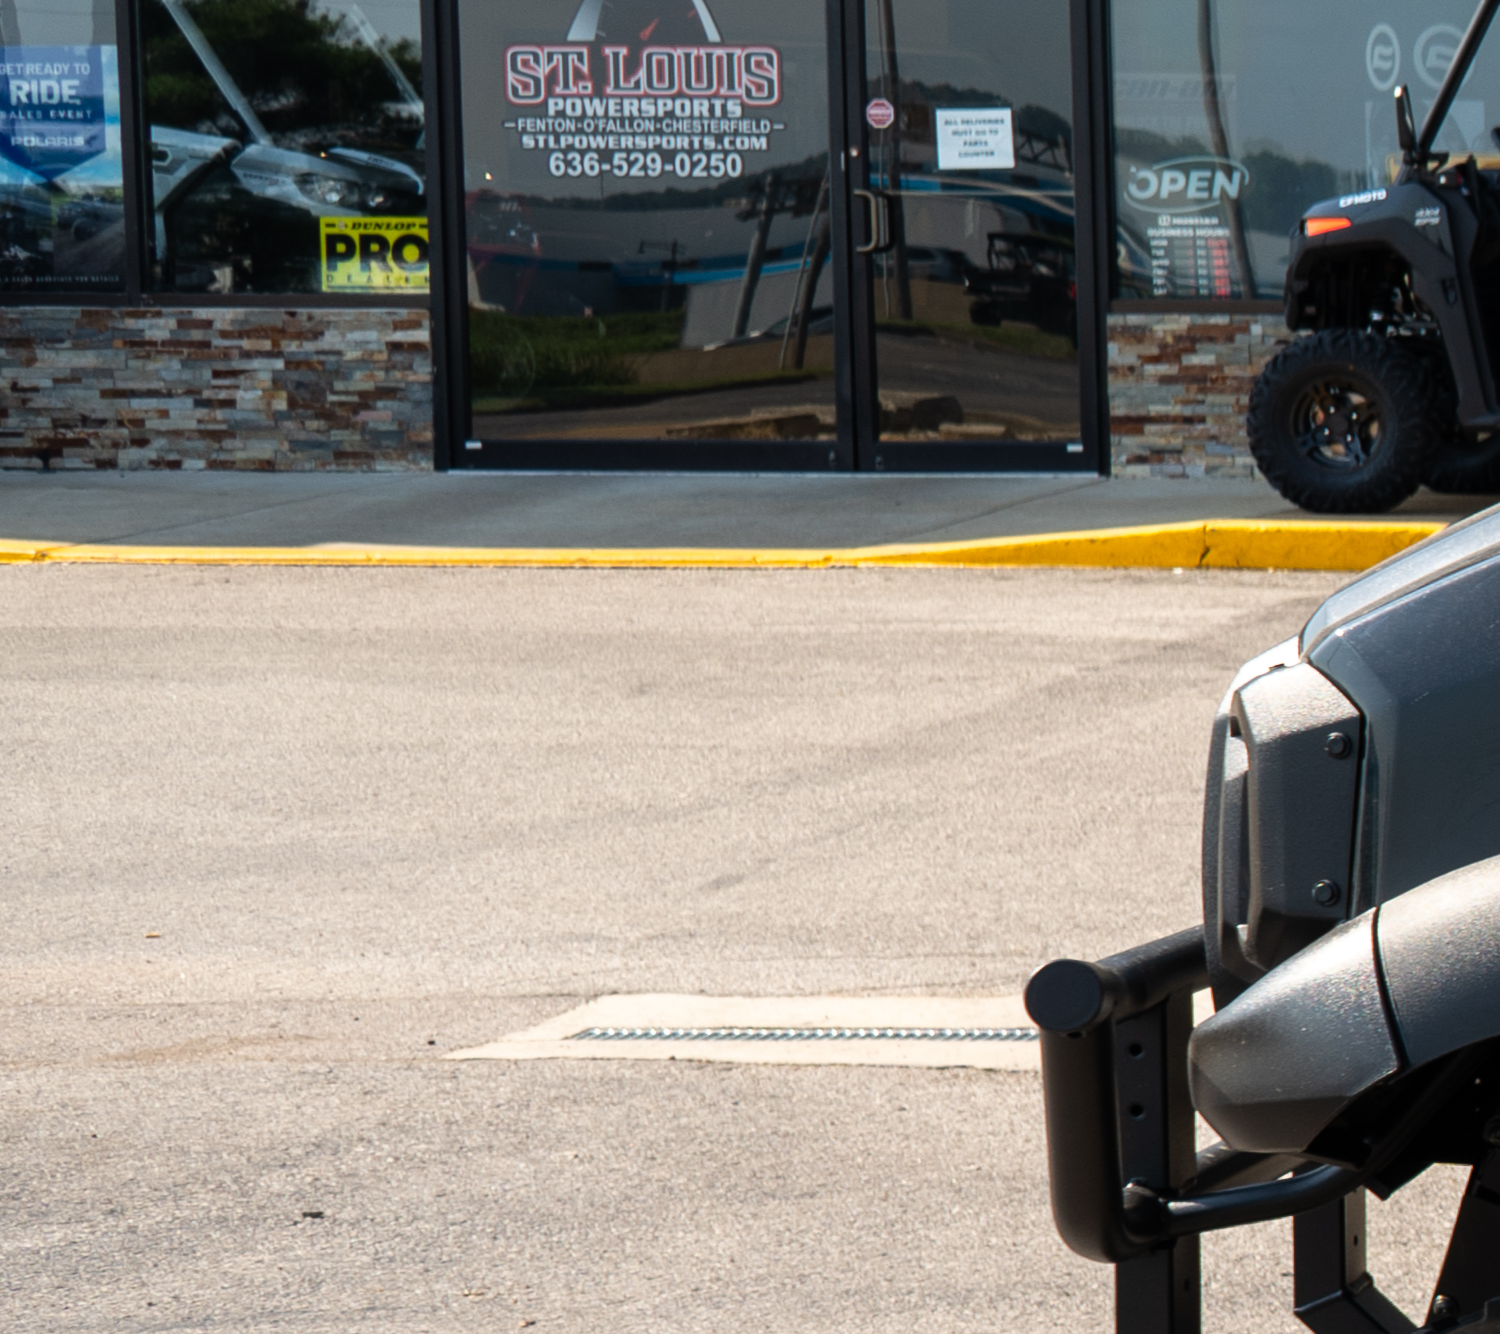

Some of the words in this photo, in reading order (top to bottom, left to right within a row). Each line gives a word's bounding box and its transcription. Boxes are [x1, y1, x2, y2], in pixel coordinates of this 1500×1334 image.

[25, 63, 70, 76] READY
[73, 63, 91, 76] TO
[506, 46, 593, 105] ST.
[602, 46, 782, 105] LOUIS
[9, 79, 81, 106] RIDE
[49, 109, 93, 120] EVENT
[547, 97, 743, 118] POWERSPORTS
[11, 136, 86, 147] POLARIS
[521, 134, 768, 151] STLPOWERSPORTS.COM
[548, 151, 744, 178] 636-529-0250
[1127, 168, 1243, 201] OPEN
[351, 221, 418, 232] DUNLOP
[325, 234, 430, 273] PRO
